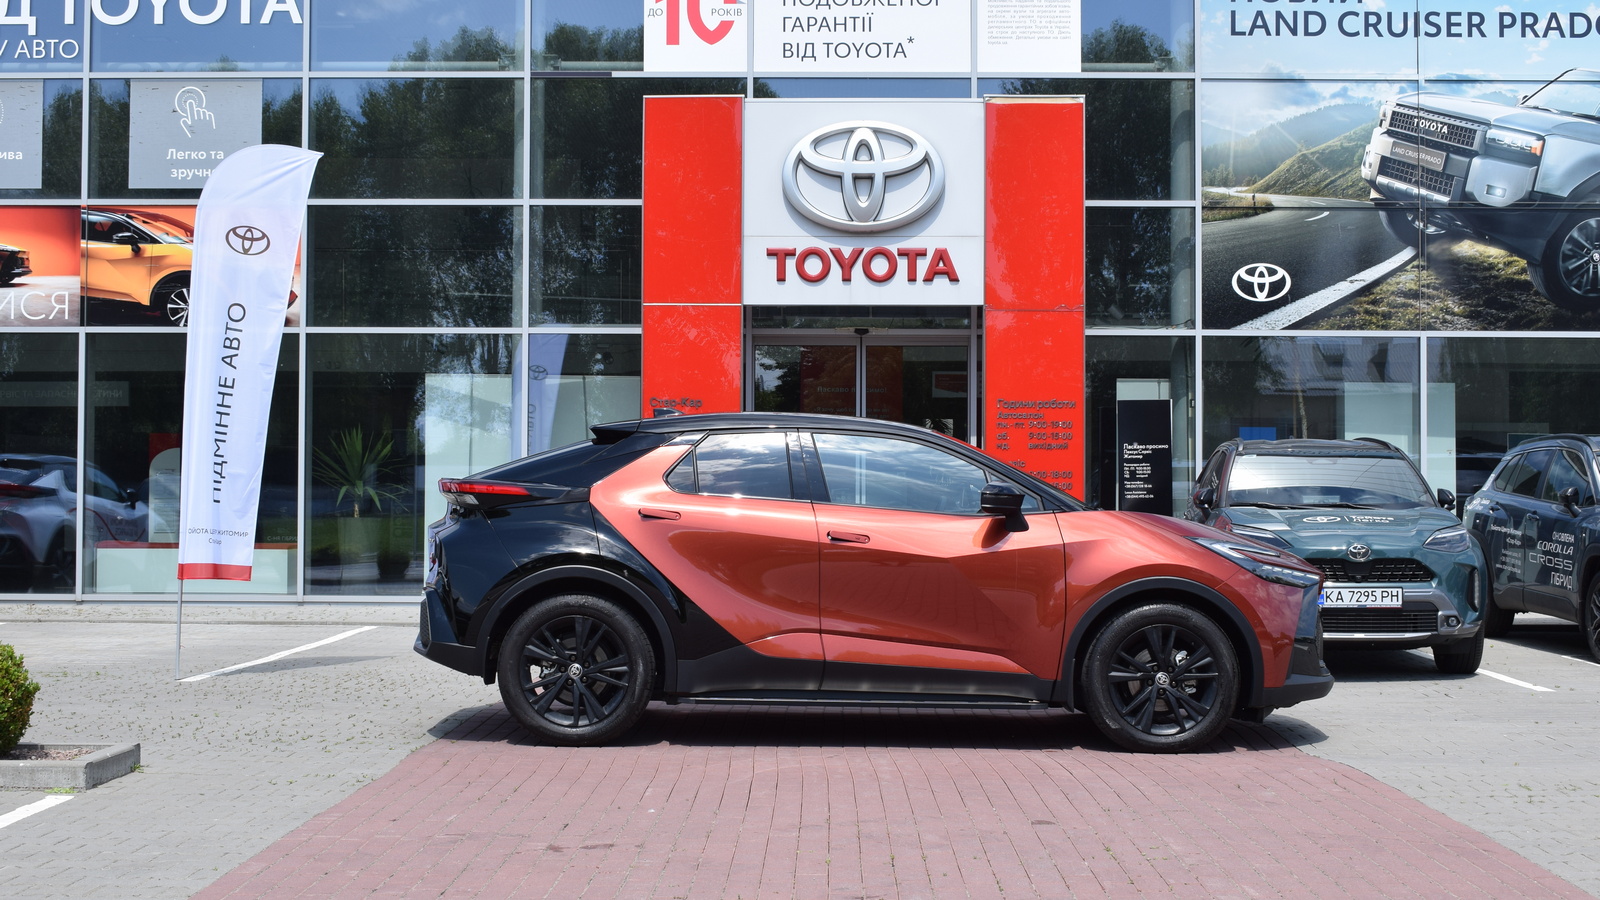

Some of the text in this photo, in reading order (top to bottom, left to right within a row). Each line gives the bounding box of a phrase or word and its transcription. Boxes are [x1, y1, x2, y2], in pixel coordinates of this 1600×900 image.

[648, 8, 743, 18] ДО РОКІВ
[782, 12, 874, 32] ГАРАНТІЇ
[1230, 10, 1327, 37] LAND
[1337, 11, 1487, 38] CRUISER
[14, 39, 79, 58] АВТО
[782, 42, 817, 62] ВІД
[1413, 119, 1448, 134] TOYOTA
[166, 148, 224, 160] Легко та
[1392, 146, 1404, 154] LAND
[766, 247, 960, 282] TOYOTA
[212, 302, 246, 504] ПІДМІННЕ АВТО
[650, 397, 702, 409] Стар-Кар
[997, 398, 1076, 410] Години роботи
[1028, 442, 1068, 450] вихідний
[1552, 531, 1575, 544] ОНОВЛЕНА
[1537, 540, 1574, 556] COROLLA
[1529, 552, 1573, 571] CROSS
[1326, 590, 1399, 603] KA 7295 PH
